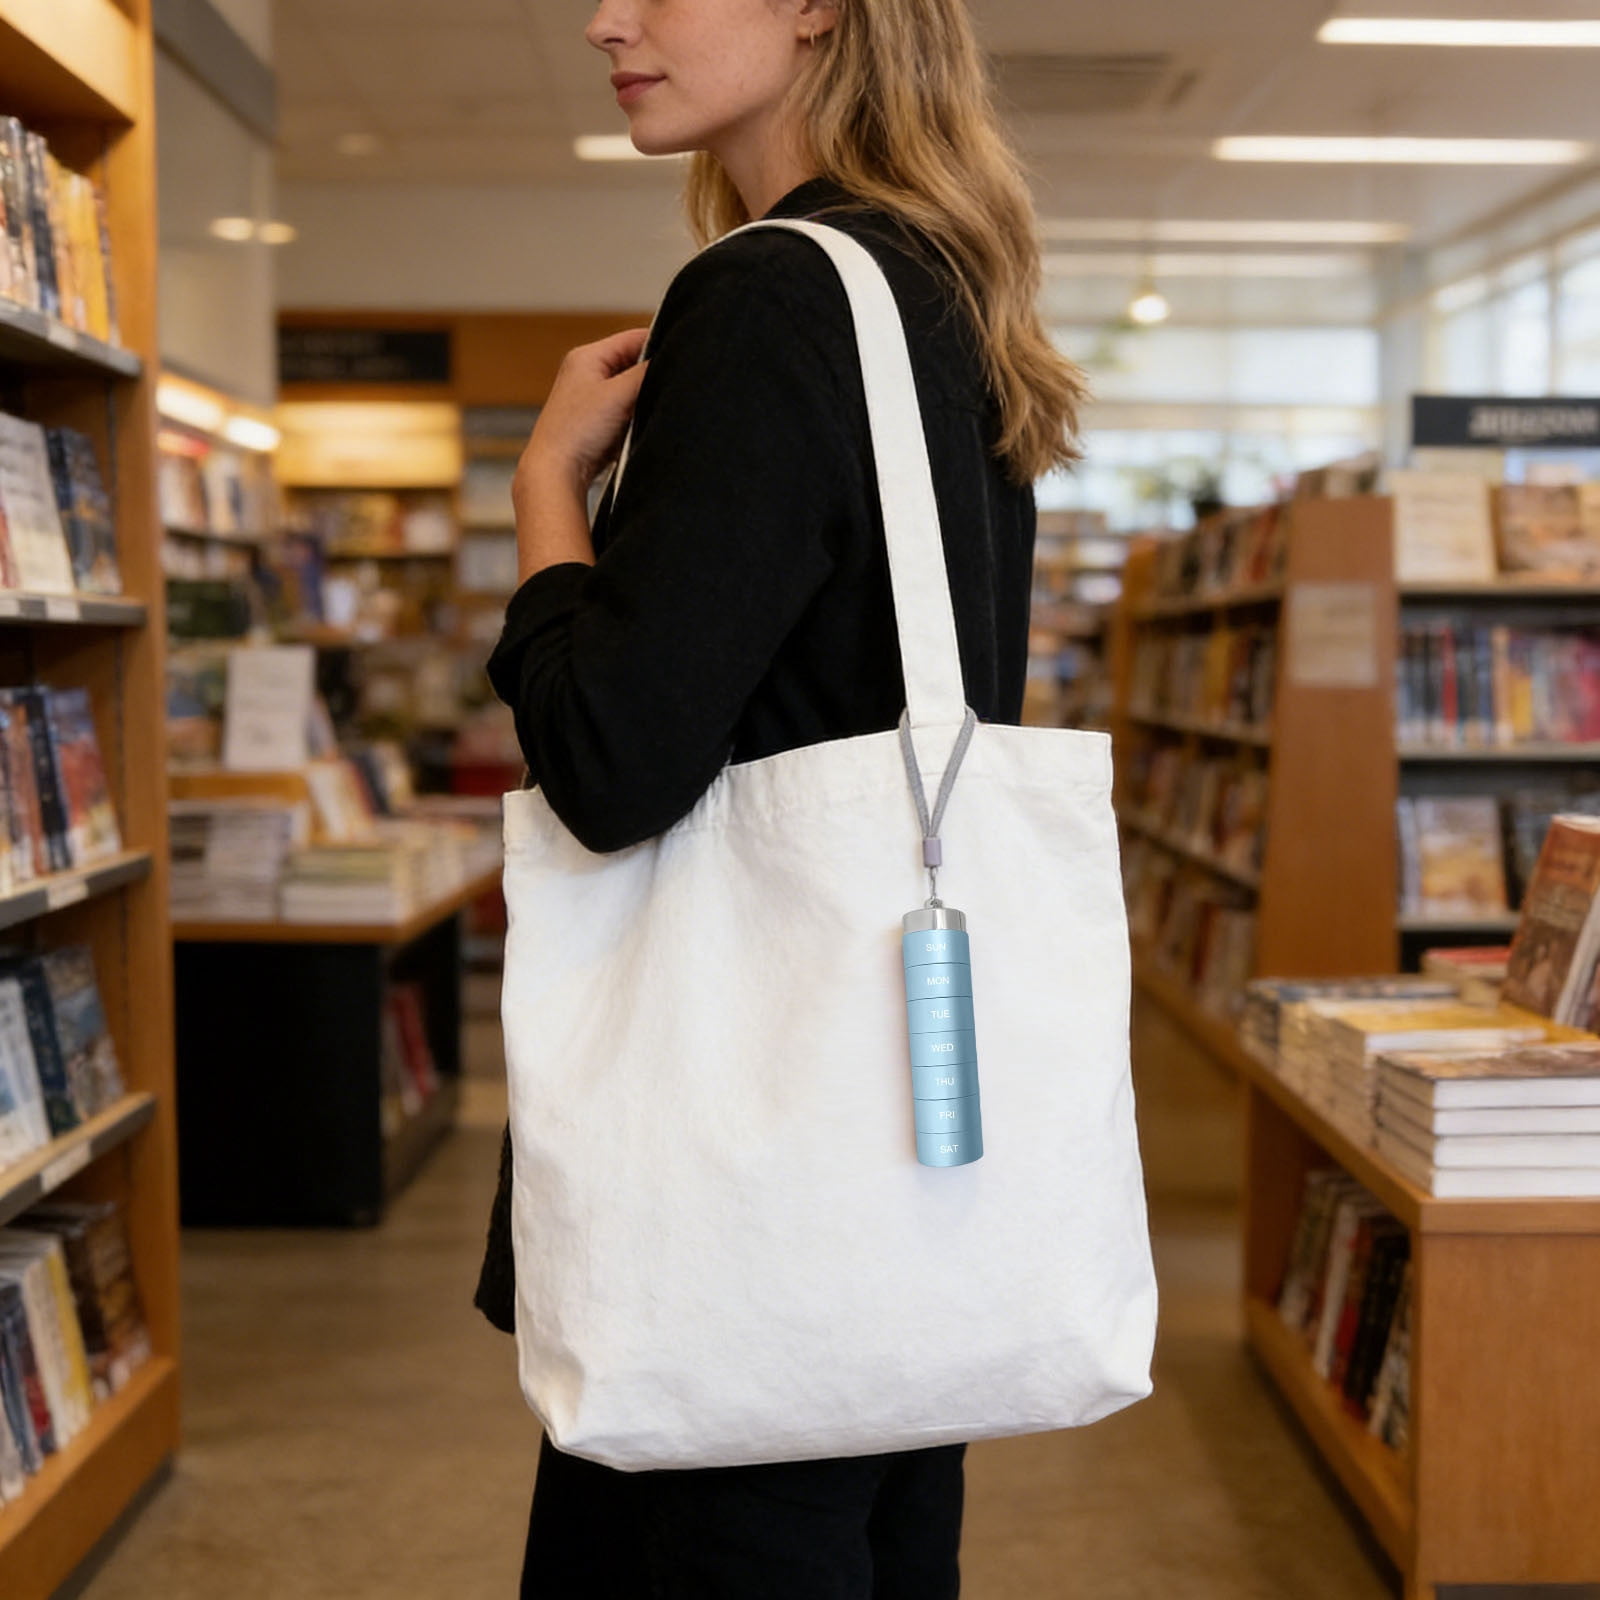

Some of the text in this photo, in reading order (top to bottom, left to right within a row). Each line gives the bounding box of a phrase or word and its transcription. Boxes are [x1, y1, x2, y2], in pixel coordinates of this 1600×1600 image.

[926, 943, 946, 952] SUN
[927, 976, 950, 985] MON
[930, 1010, 950, 1019] TUE
[932, 1043, 954, 1052] WED
[935, 1077, 954, 1086] THU
[938, 1111, 955, 1119] FRI
[940, 1144, 959, 1153] SAT
